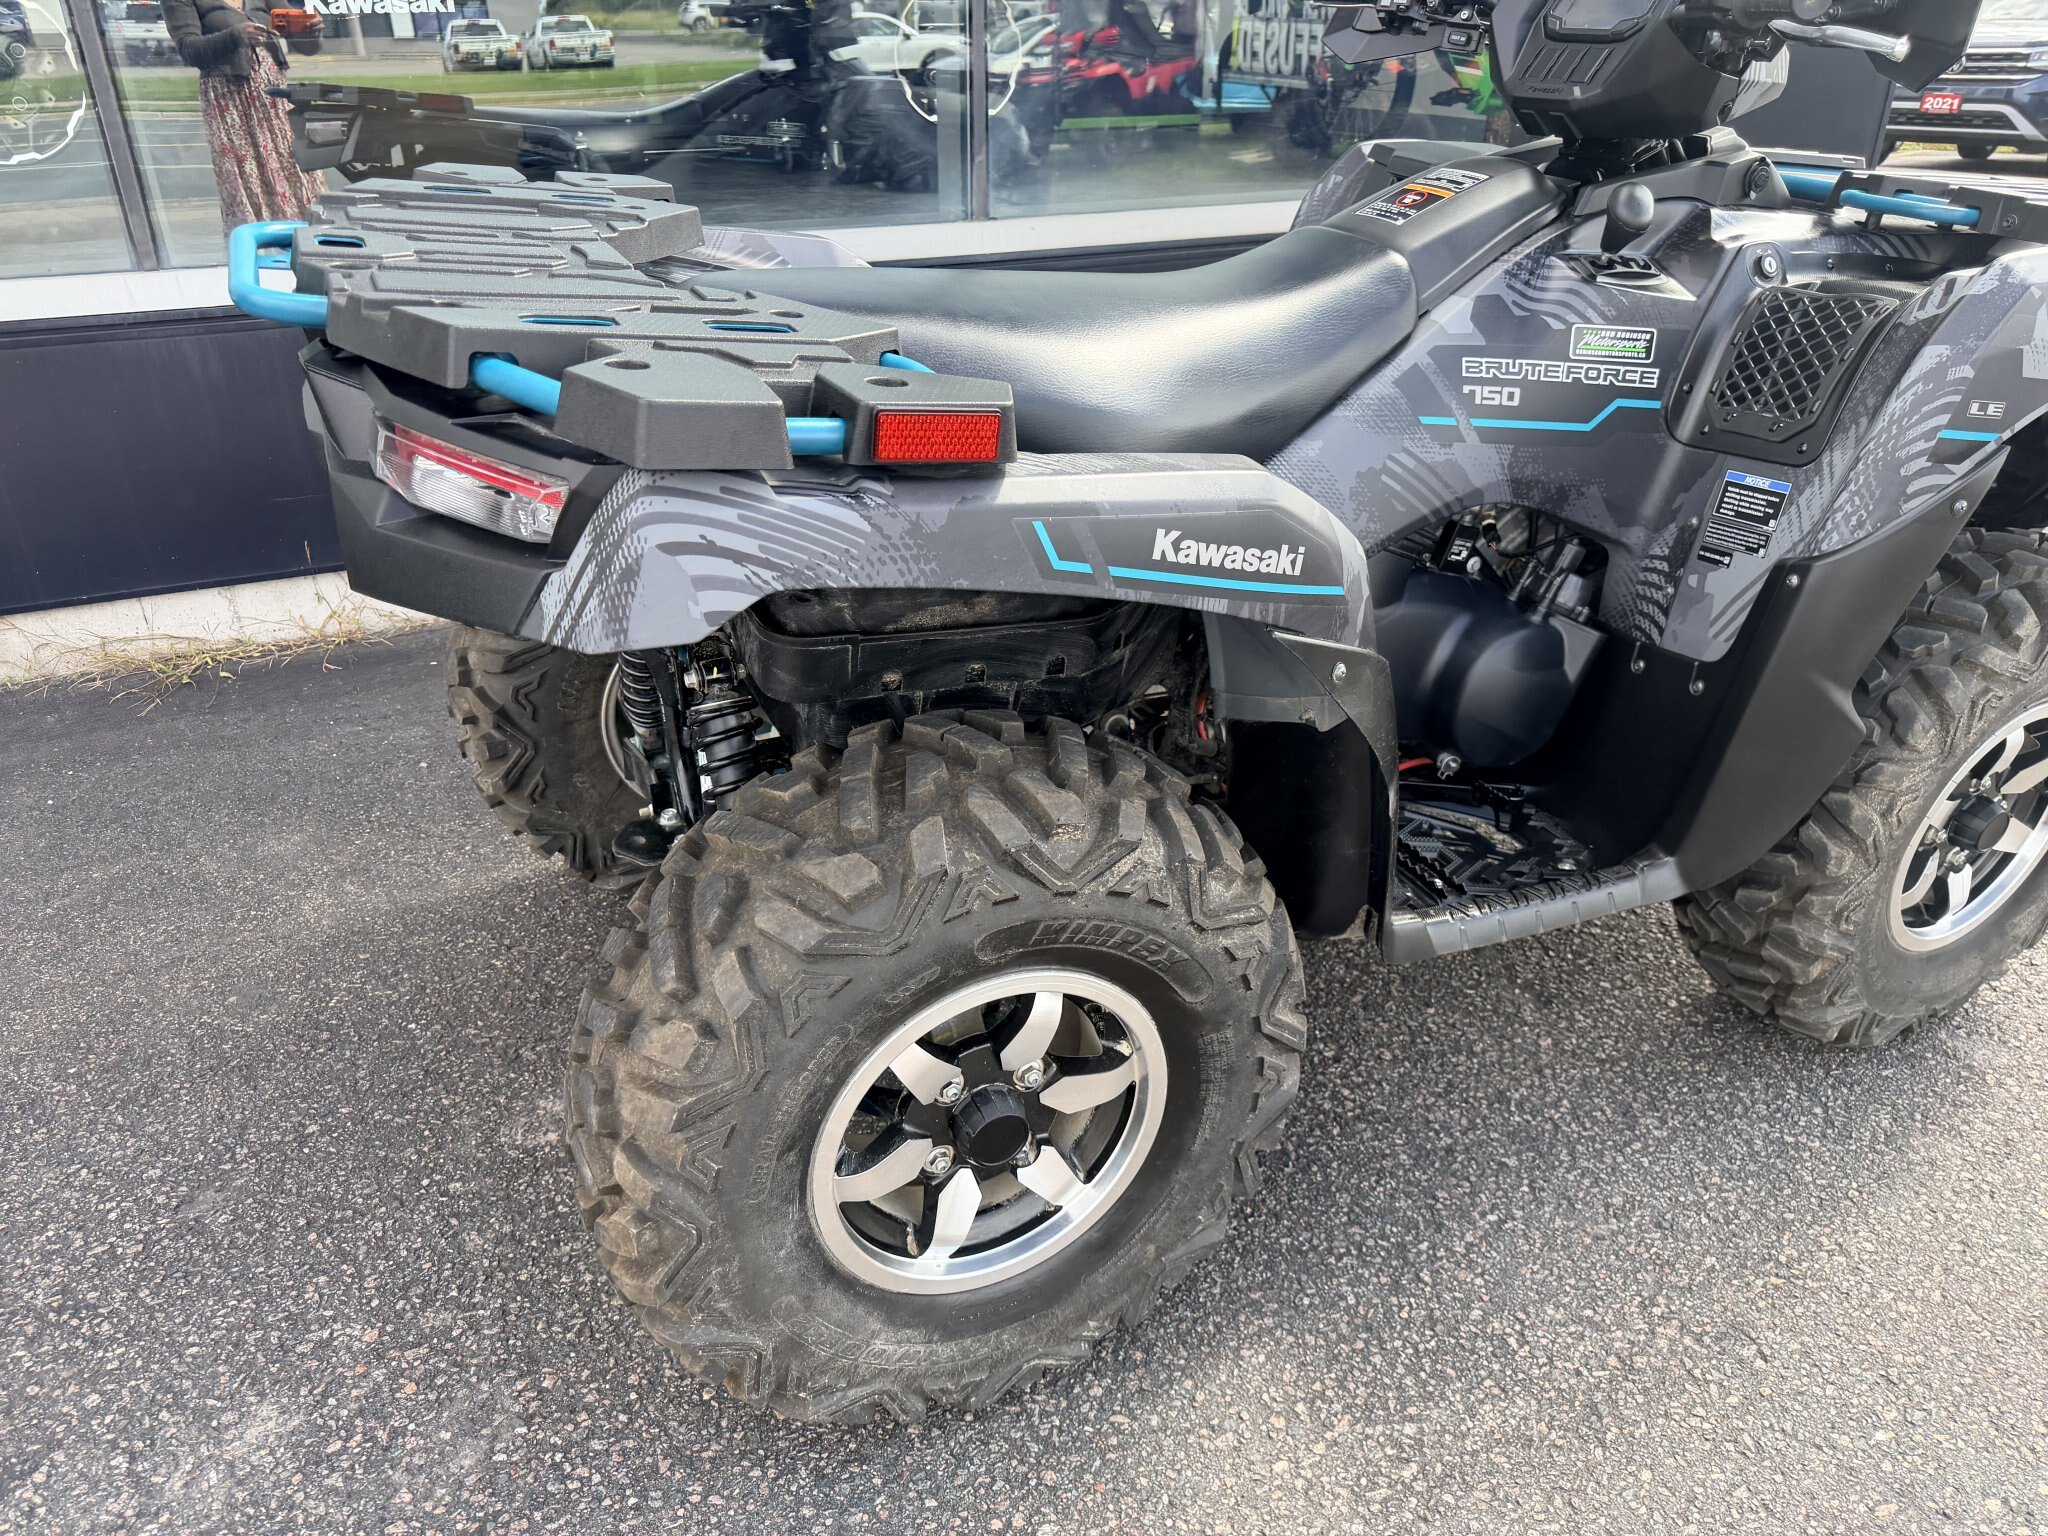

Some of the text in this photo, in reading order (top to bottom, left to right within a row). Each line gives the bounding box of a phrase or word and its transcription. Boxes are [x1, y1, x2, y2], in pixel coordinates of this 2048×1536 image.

[1922, 96, 1960, 110] 2021
[1577, 333, 1650, 352] Motorsports
[1462, 385, 1521, 407] 750
[1969, 402, 2004, 416] LE
[1743, 476, 1772, 489] NOTICE
[1152, 528, 1306, 576] Kawasaki
[1029, 919, 1190, 974] KIMPEX
